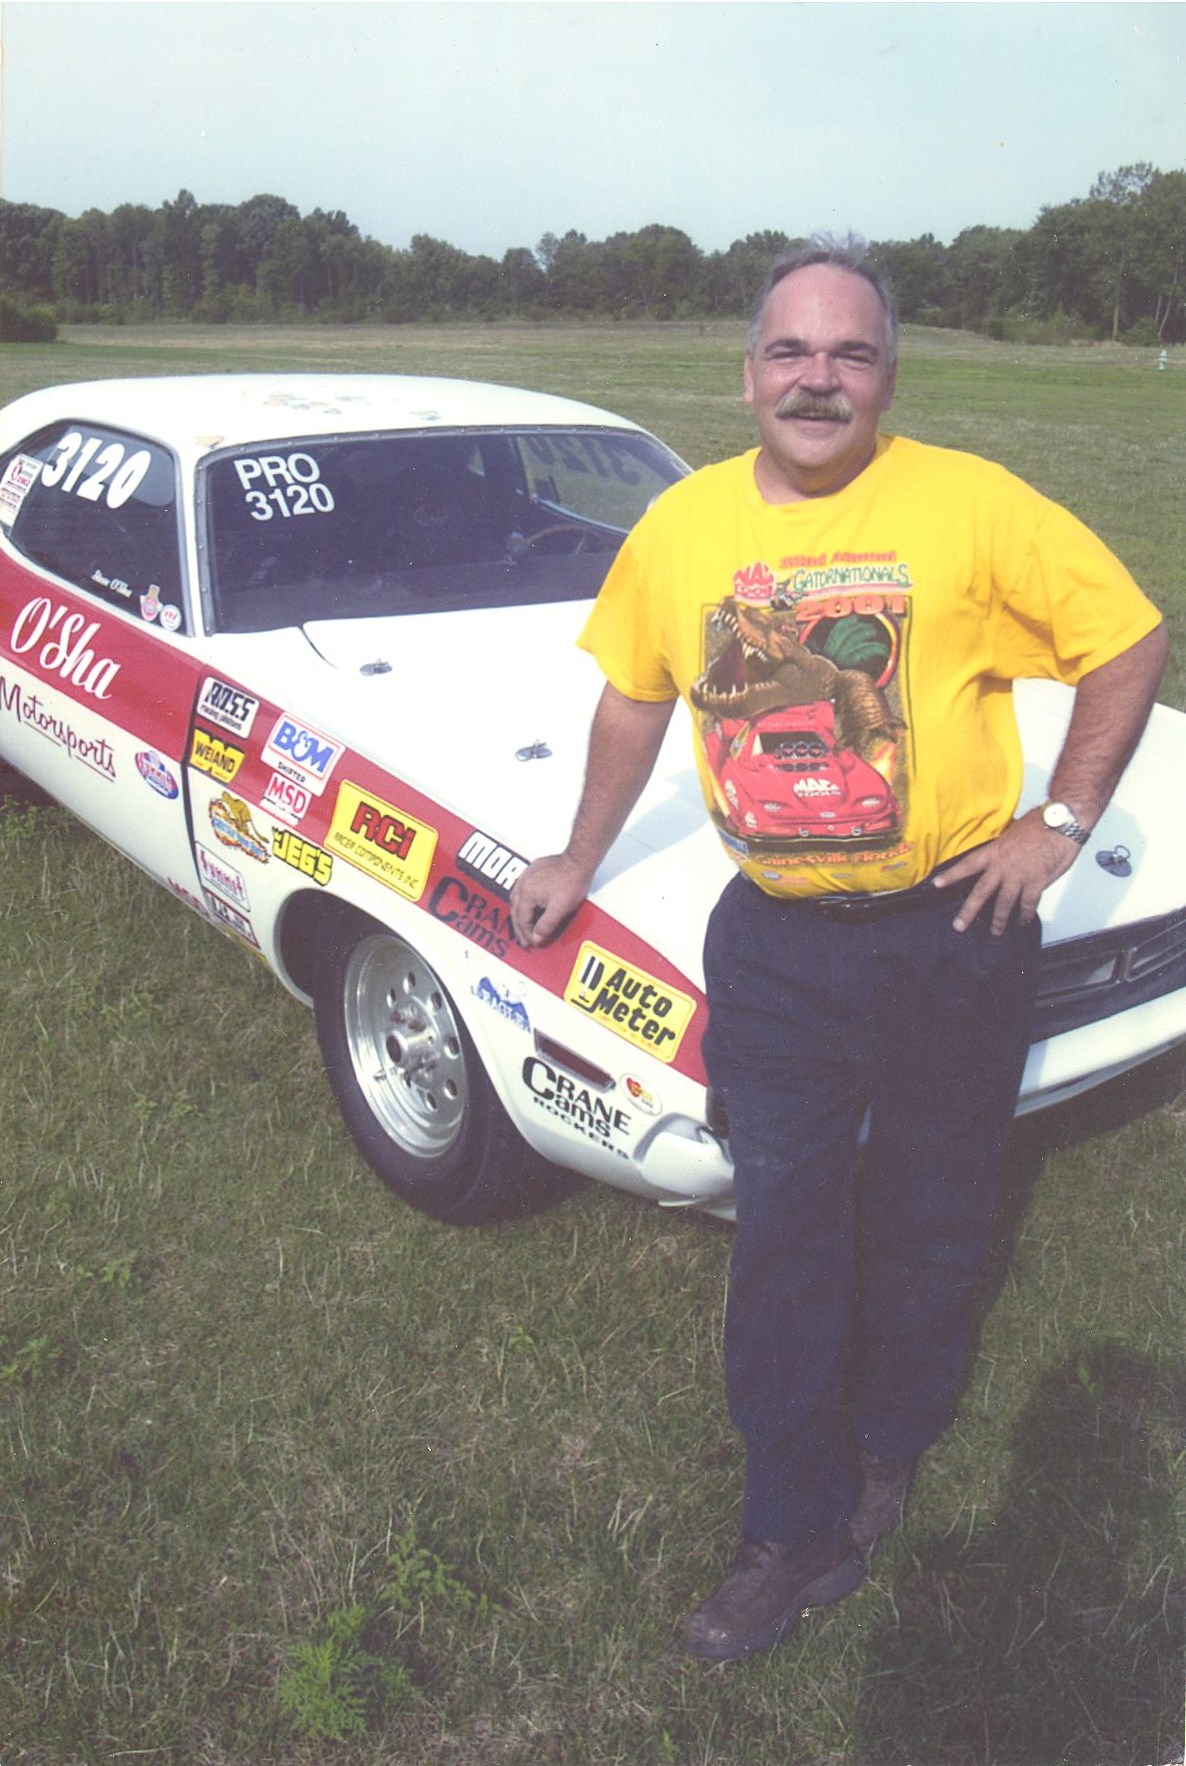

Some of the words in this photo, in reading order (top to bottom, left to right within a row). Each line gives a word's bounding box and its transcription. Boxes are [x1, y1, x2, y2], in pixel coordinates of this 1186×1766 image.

[41, 432, 151, 509] 3120
[234, 453, 320, 490] PRO
[245, 483, 335, 521] 3120
[794, 594, 908, 622] 2001
[10, 597, 121, 699] O'Sha
[0, 675, 117, 778] Motorsports
[204, 681, 256, 722] ROSS
[195, 740, 236, 773] WEIAND
[273, 721, 335, 773] B&M
[267, 777, 307, 814] MSD
[587, 986, 677, 1046] Meter
[605, 967, 673, 1019] Auto
[522, 1056, 632, 1136] CRANE
